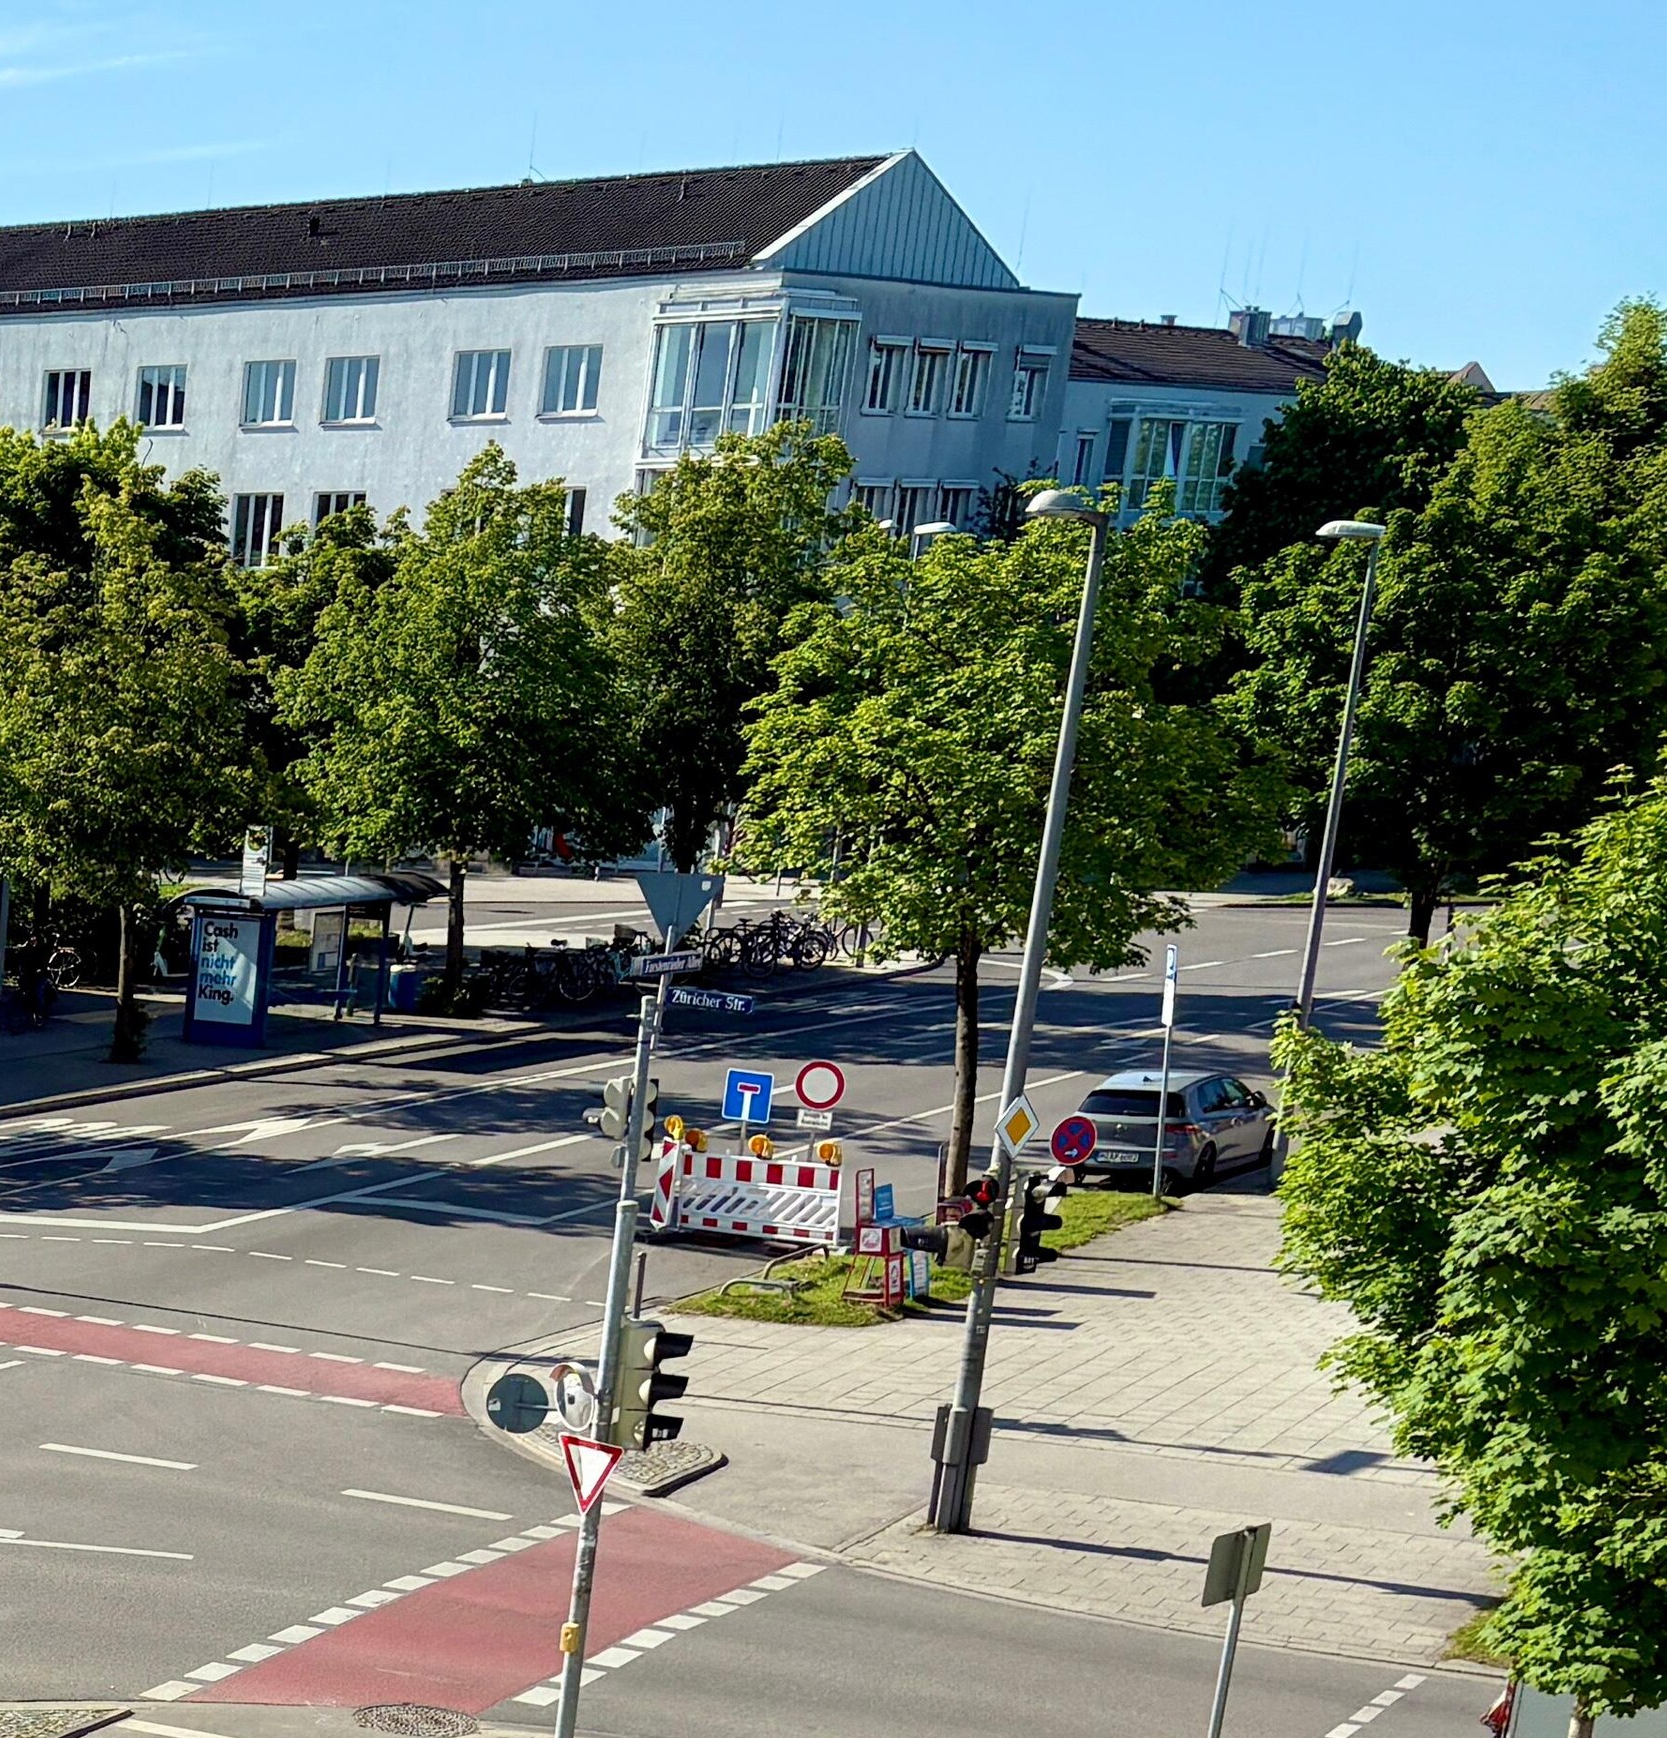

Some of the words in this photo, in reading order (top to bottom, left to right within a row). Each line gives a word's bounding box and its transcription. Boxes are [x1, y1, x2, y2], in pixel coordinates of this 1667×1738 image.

[204, 921, 239, 938] Cash
[202, 936, 219, 952] ist
[201, 954, 236, 969] nicht
[200, 969, 237, 987] mehr
[198, 984, 233, 1005] King.
[672, 989, 722, 1008] Züricher
[725, 997, 746, 1011] Str.
